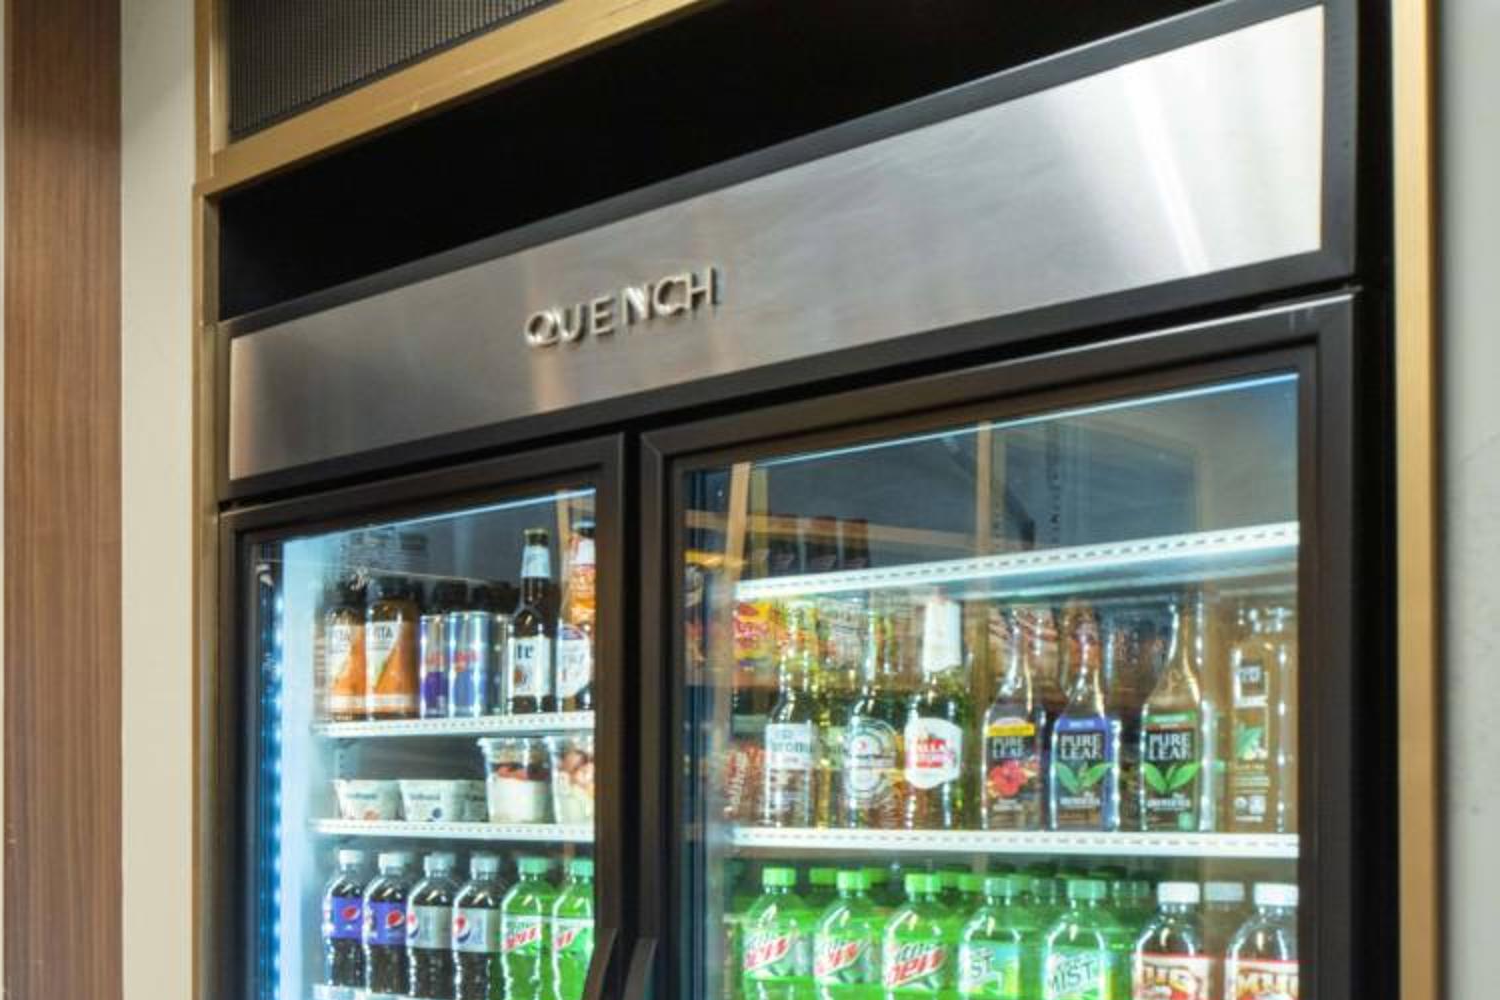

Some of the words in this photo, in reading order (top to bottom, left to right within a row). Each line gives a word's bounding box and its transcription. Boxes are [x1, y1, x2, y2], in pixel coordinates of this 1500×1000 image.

[524, 266, 715, 348] QUENCH
[1060, 734, 1100, 747] PURE
[1149, 733, 1191, 747] PURE
[1060, 747, 1100, 760] LEAF
[1149, 747, 1191, 760] LEAF
